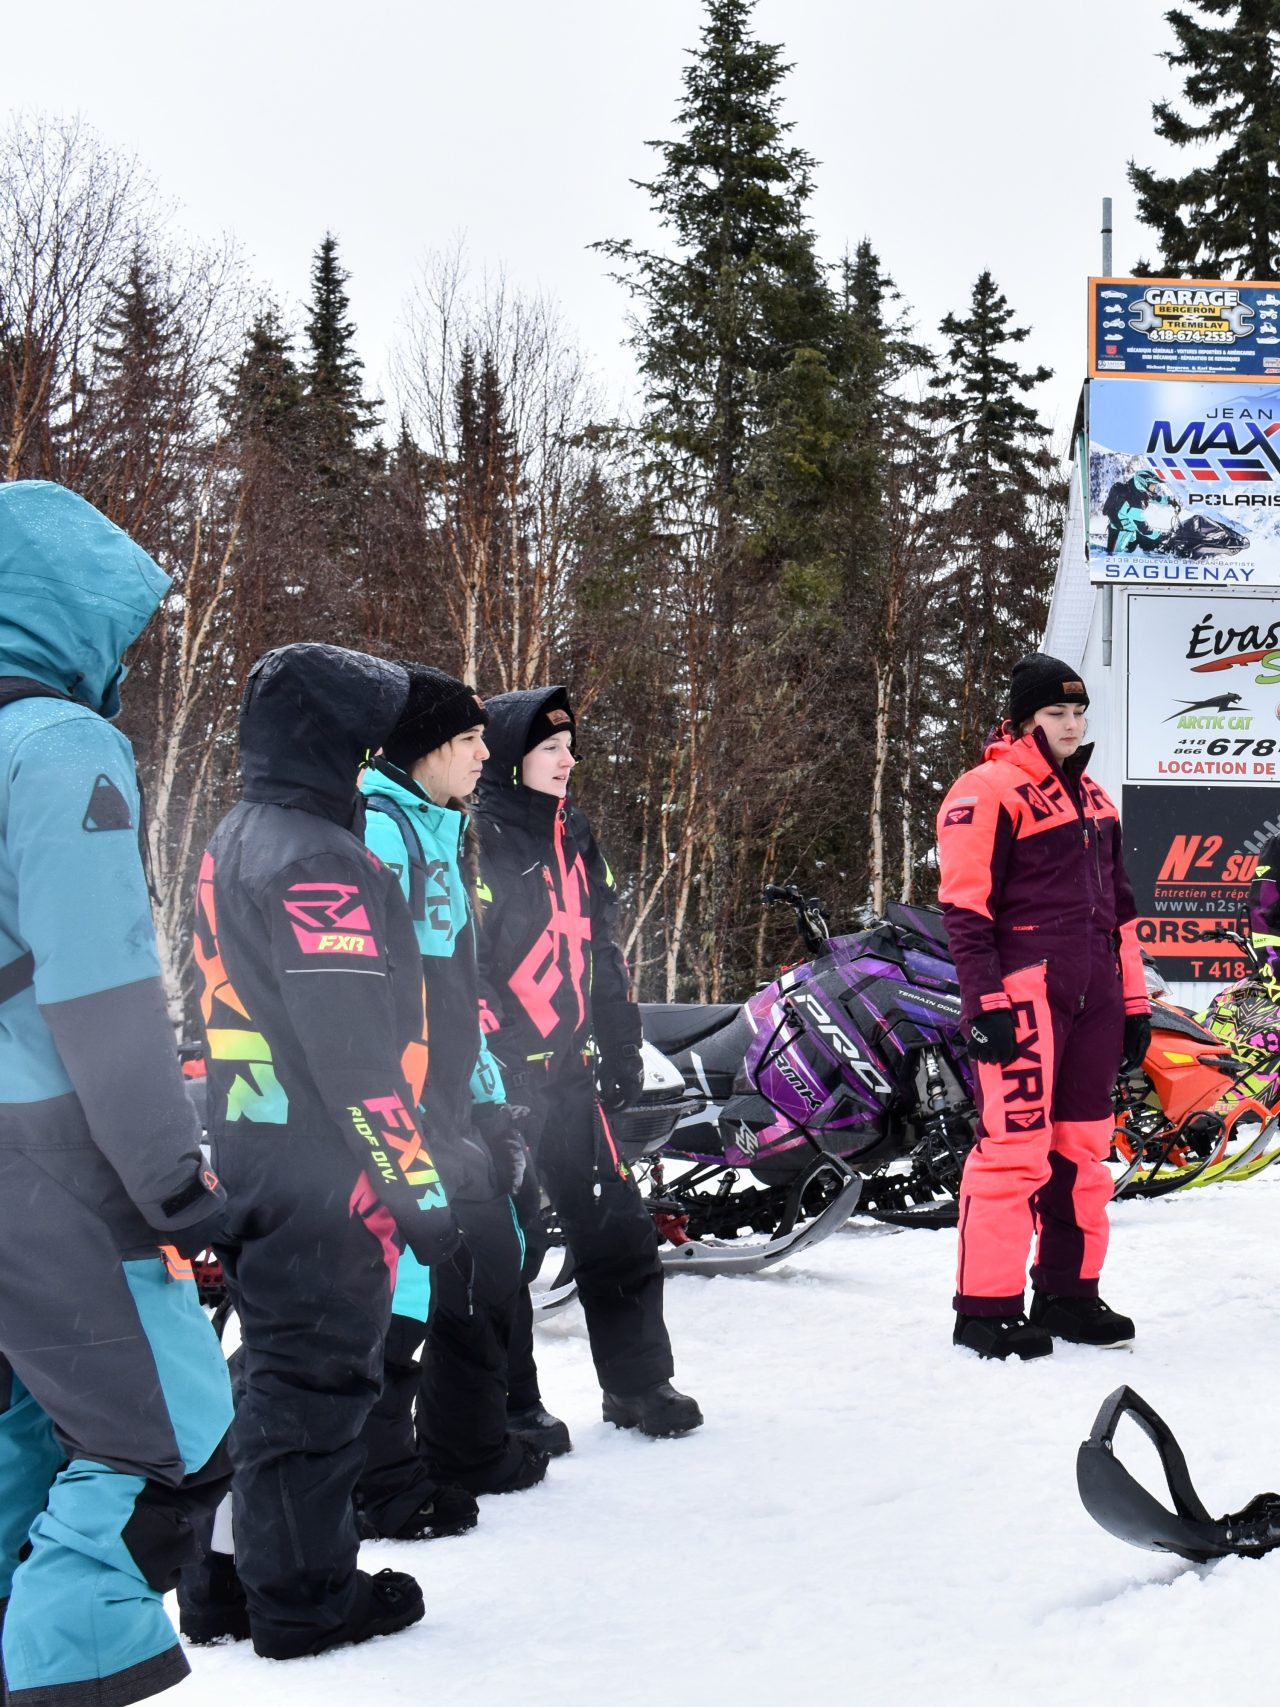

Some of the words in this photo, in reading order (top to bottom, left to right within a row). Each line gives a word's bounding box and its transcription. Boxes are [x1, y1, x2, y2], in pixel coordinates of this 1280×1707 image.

[1145, 289, 1238, 307] GARAGE
[1167, 321, 1224, 329] TREMBLAY
[1150, 330, 1233, 341] 418-674-2535
[1207, 408, 1273, 420] JEAN
[1105, 564, 1254, 582] SAGUENAY
[1177, 716, 1225, 730] ARCTIC
[1228, 716, 1254, 730] CAT
[1158, 761, 1247, 775] LOCATION
[1253, 762, 1276, 775] DE
[1155, 888, 1206, 898] Entretien
[1211, 889, 1222, 898] et
[318, 935, 365, 952] FXR
[1191, 961, 1203, 978] T
[899, 990, 936, 1006] TERRAIN
[1001, 1001, 1043, 1103] FXR
[362, 1092, 448, 1210] FXR
[371, 1151, 398, 1184] DIV.
